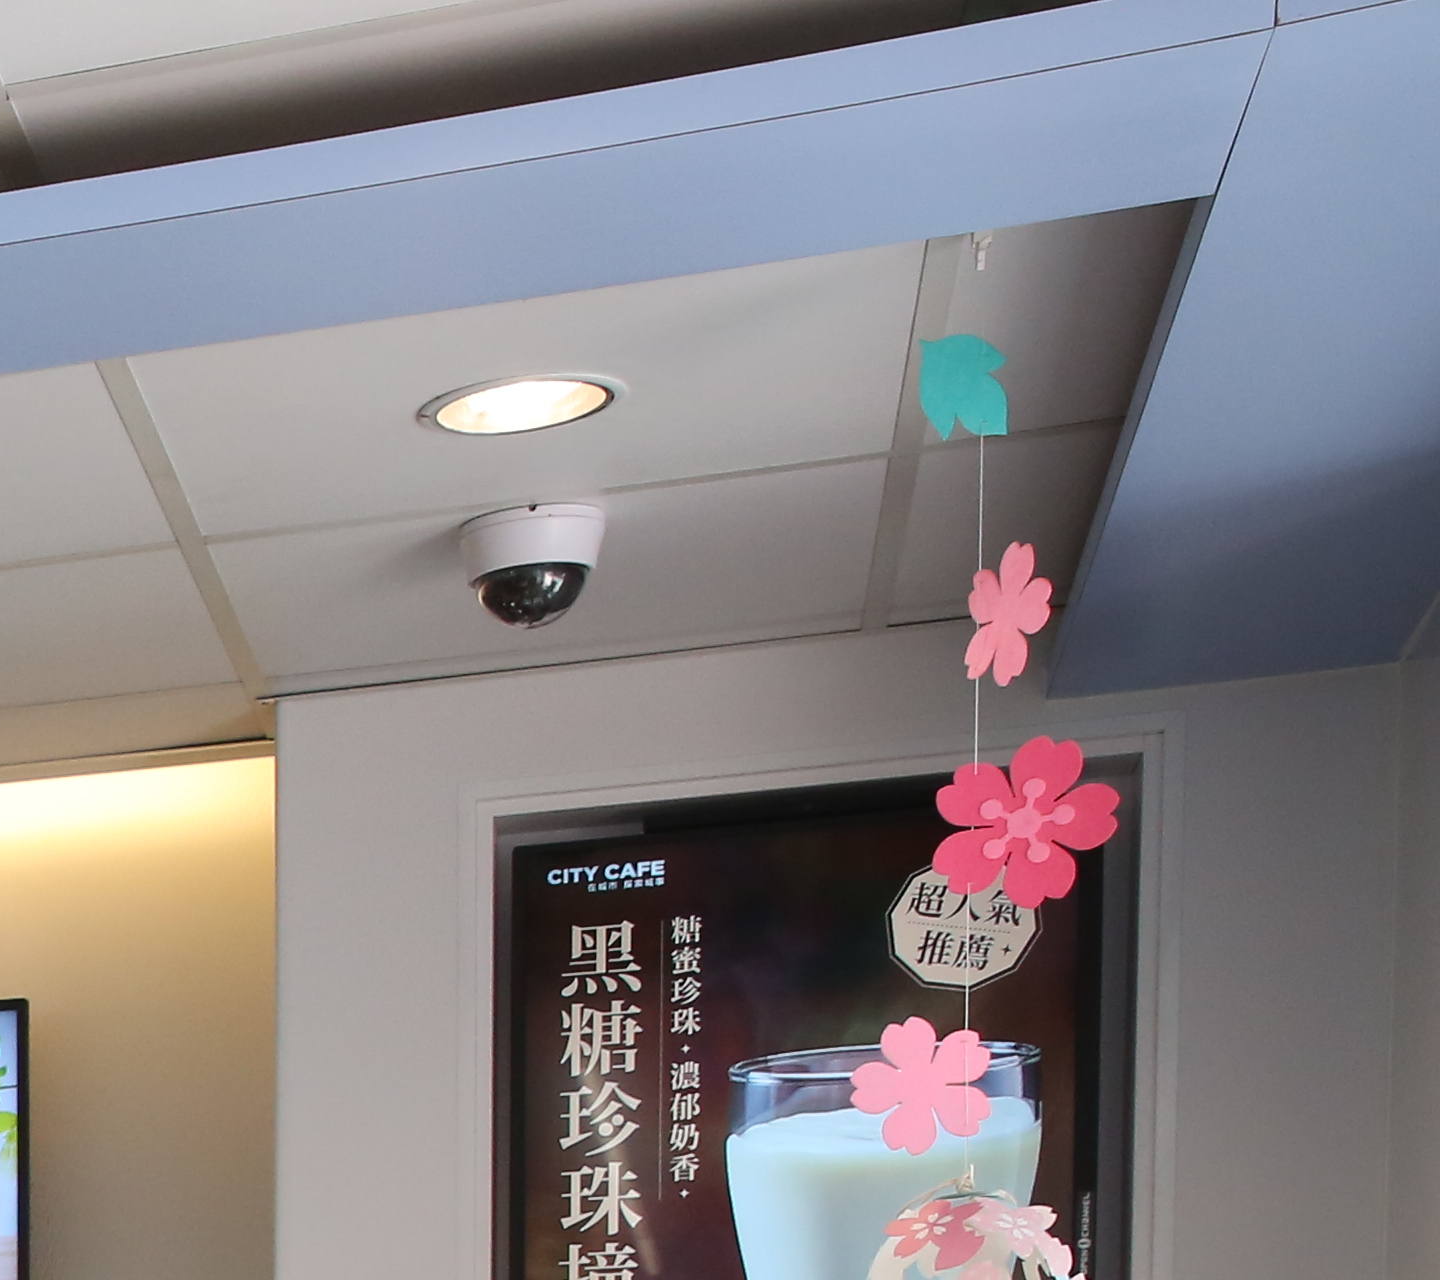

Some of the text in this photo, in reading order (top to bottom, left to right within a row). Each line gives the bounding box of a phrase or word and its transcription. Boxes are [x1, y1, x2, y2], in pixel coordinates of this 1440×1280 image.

[547, 860, 666, 885] CITY CAFE
[905, 882, 1022, 926] 超人氣
[915, 930, 994, 971] 推薦
[670, 915, 702, 1183] 糖蜜珍珠 濃郁奶香
